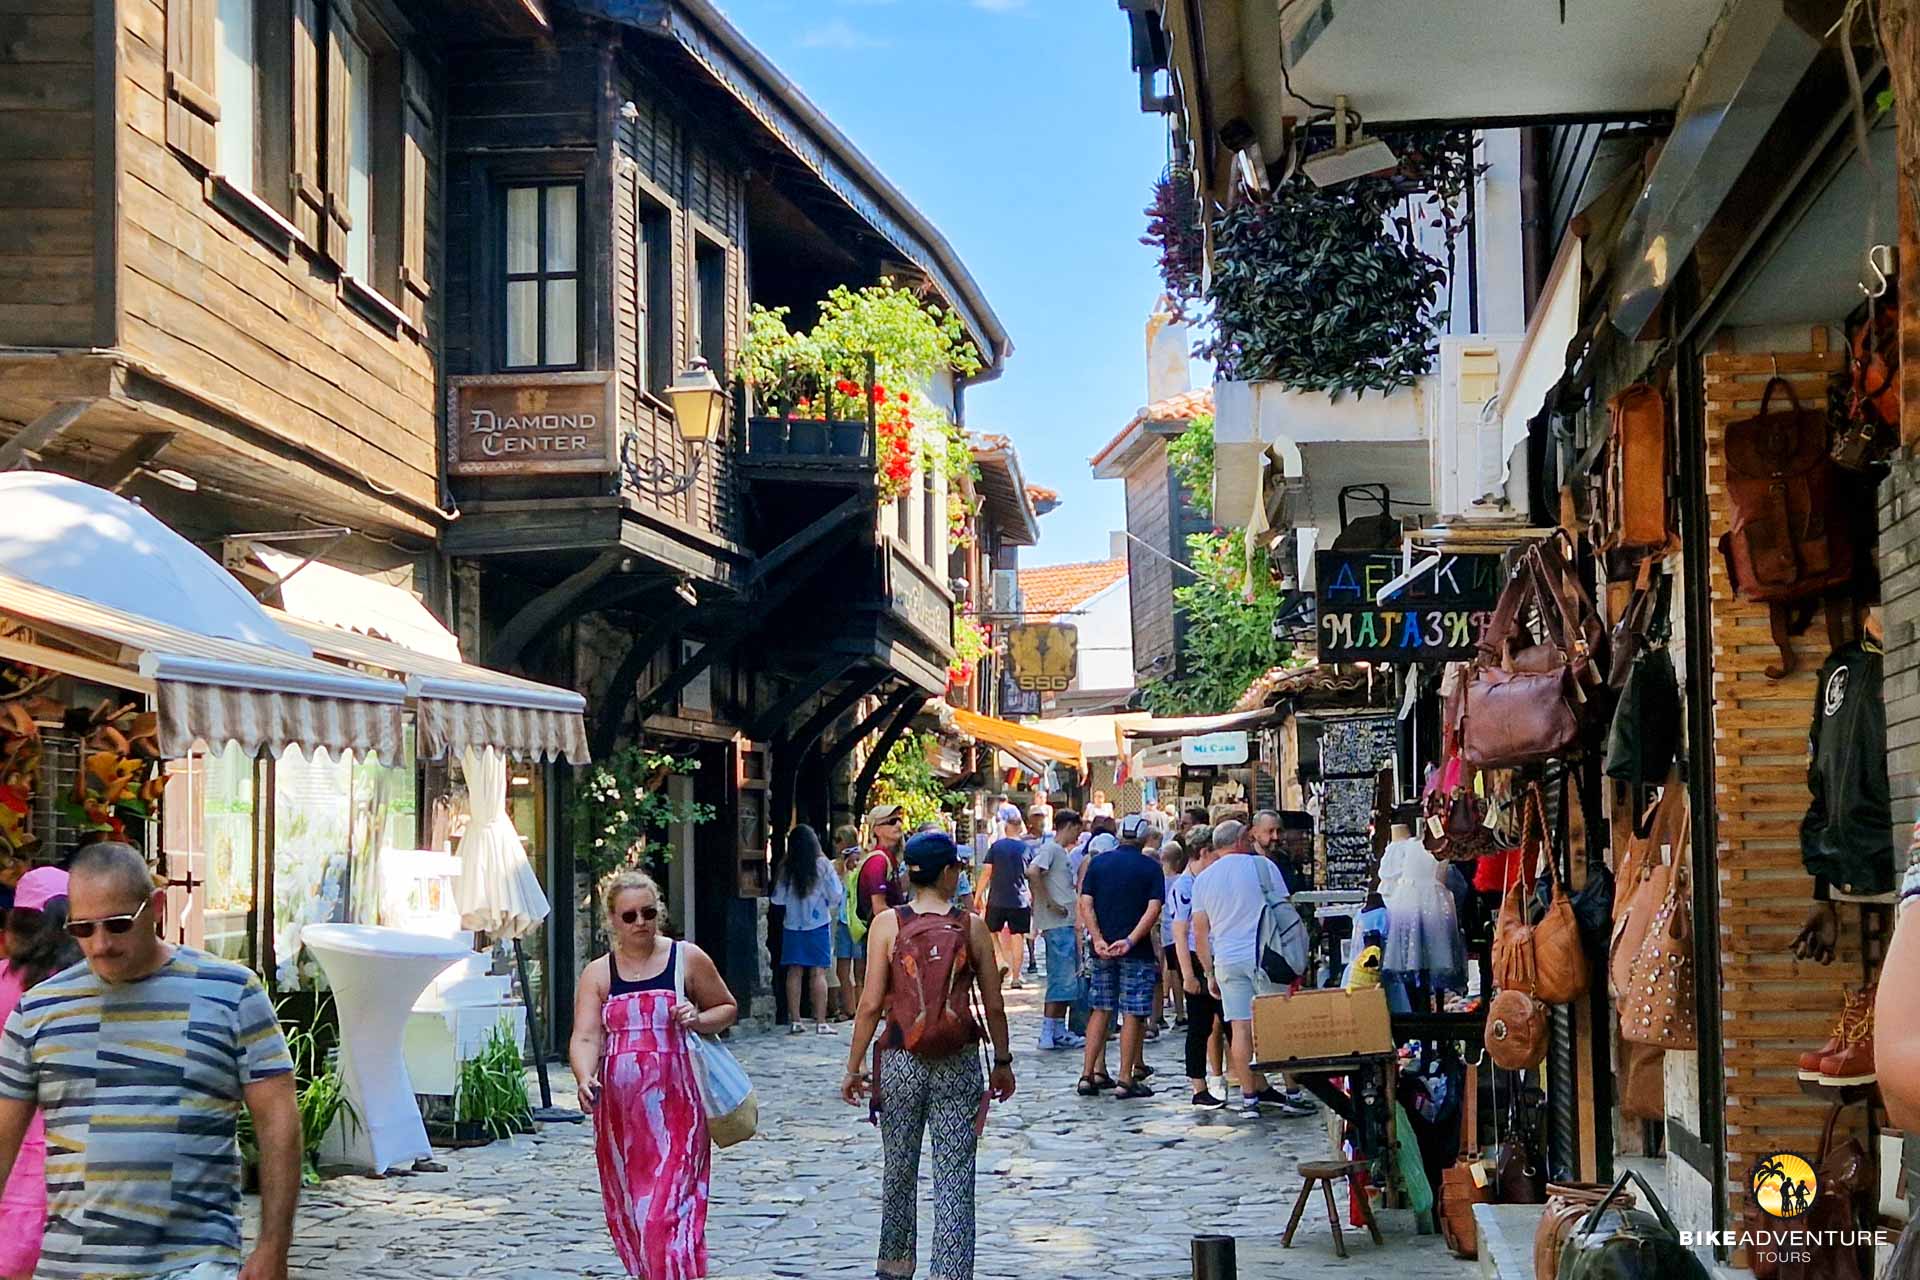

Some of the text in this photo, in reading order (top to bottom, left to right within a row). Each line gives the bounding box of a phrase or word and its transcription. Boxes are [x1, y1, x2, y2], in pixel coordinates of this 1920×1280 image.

[470, 409, 597, 433] DIAMOND
[481, 432, 588, 456] CENTER
[1019, 675, 1068, 691] SSG
